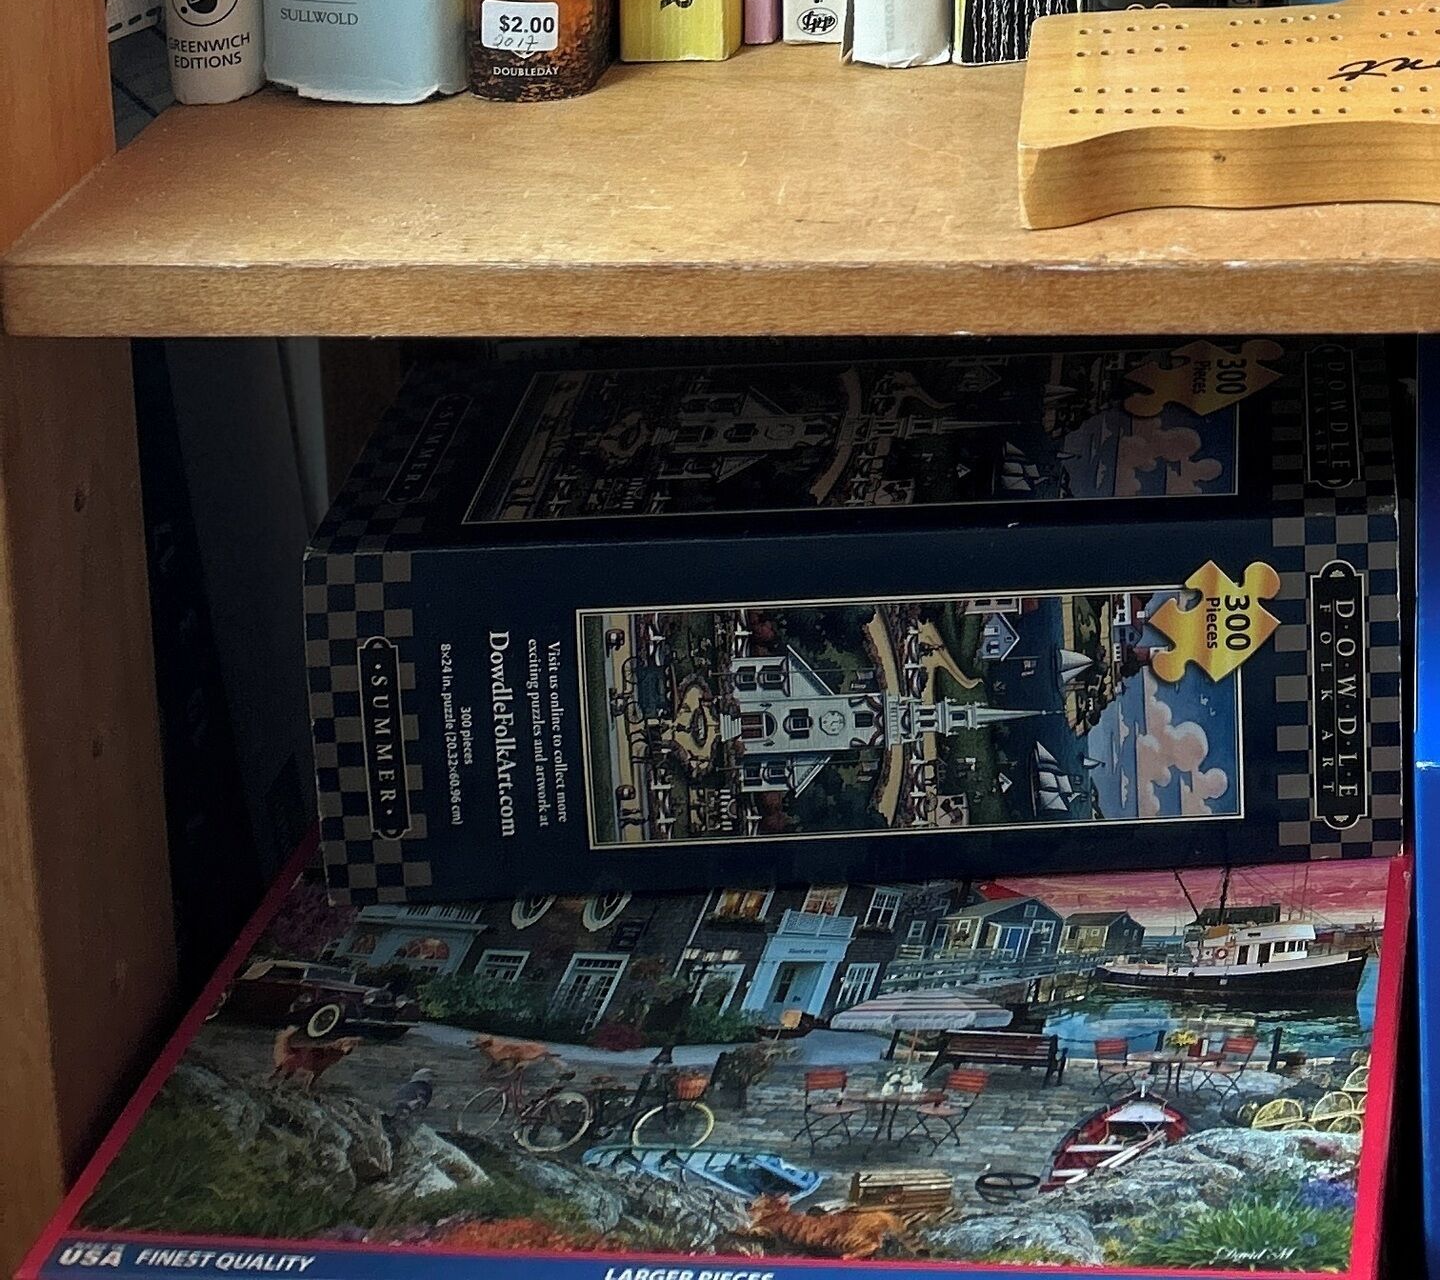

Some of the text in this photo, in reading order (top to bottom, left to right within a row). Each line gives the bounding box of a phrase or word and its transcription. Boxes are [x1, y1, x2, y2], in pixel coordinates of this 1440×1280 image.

[280, 8, 358, 25] SULLWOLD
[499, 15, 554, 34] $2.00
[174, 51, 242, 69] EDITIONS
[493, 67, 559, 77] DOUBLEDAY
[1205, 597, 1218, 650] Pieces
[1224, 594, 1252, 652] 300
[370, 674, 397, 804] SUMMER
[489, 630, 516, 838] DowdleFolkArt.com
